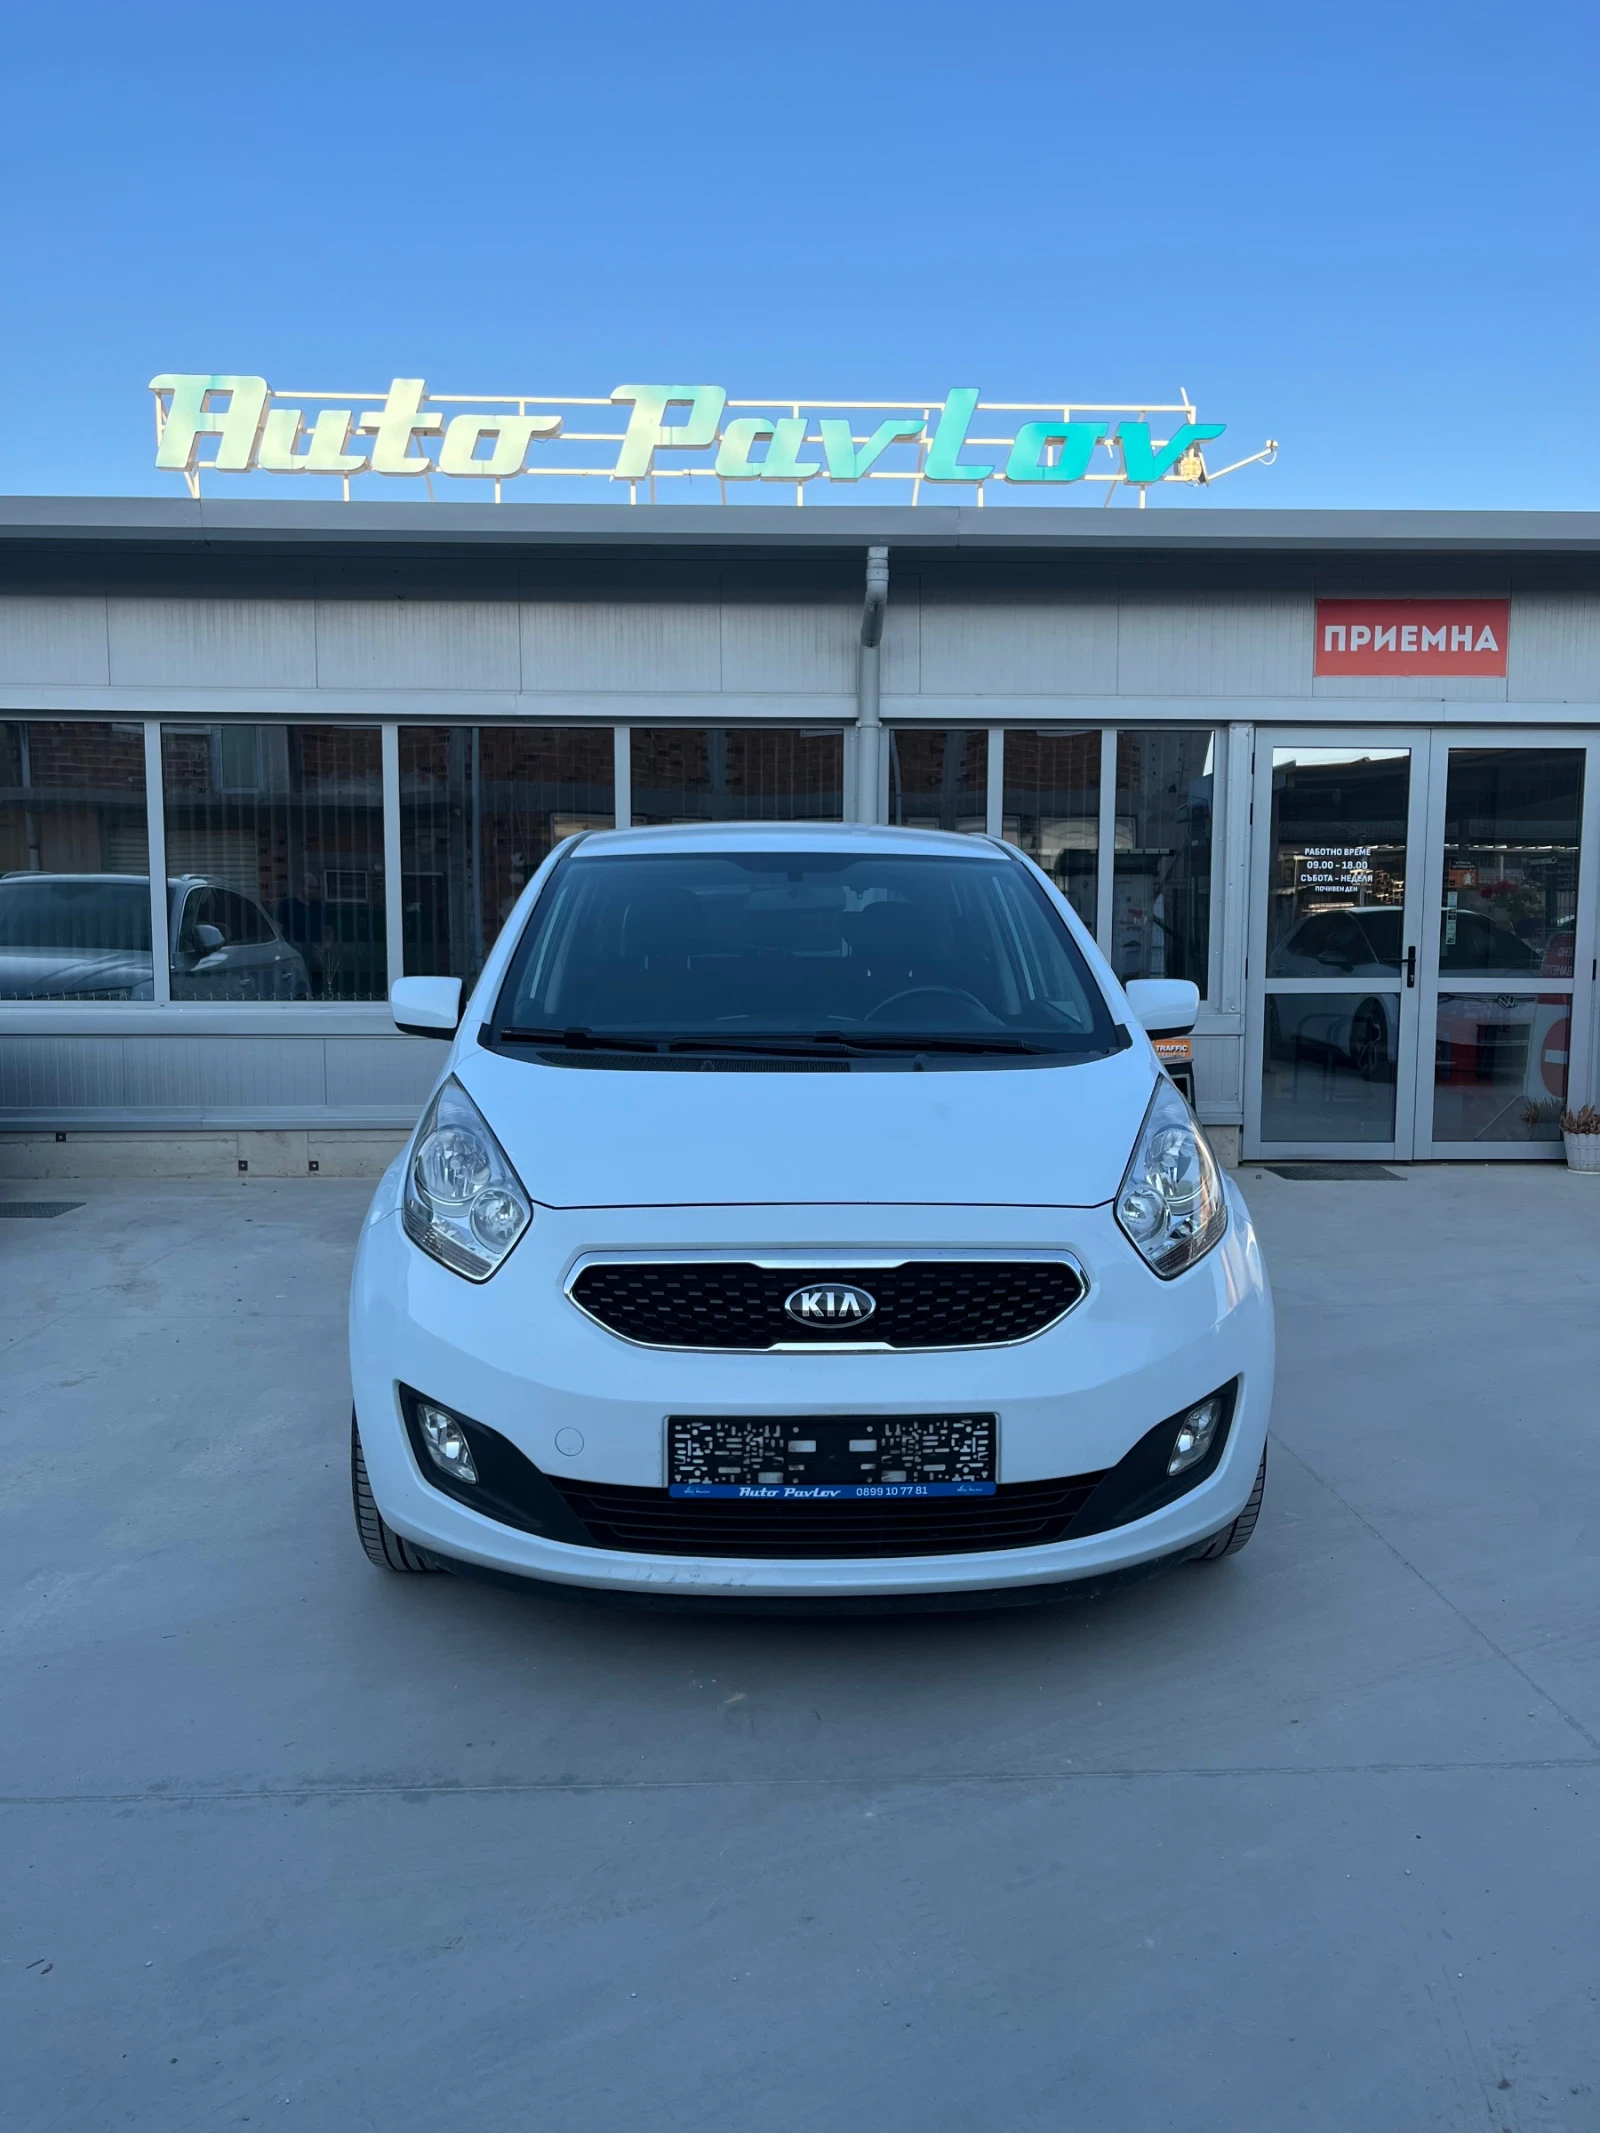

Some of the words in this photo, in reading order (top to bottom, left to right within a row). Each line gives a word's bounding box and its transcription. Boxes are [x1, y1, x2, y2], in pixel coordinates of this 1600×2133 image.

[148, 373, 564, 480] Auto
[1323, 624, 1500, 652] ПРИЕМНА
[1304, 847, 1342, 856] РАБОТНО
[1343, 848, 1372, 856] ВРЕМЕ
[1306, 860, 1334, 870] 09.00
[1341, 860, 1368, 870] 18.00
[1300, 874, 1334, 882] СЪБОТА
[1340, 874, 1373, 883] НЕДЕЛЯ
[1345, 885, 1358, 893] ДЕН
[1155, 1044, 1188, 1053] TRAFFIC
[800, 1292, 862, 1317] KIA
[738, 1486, 779, 1497] Auto
[856, 1487, 884, 1497] 0899
[885, 1487, 899, 1496] 10
[900, 1486, 914, 1496] 77
[915, 1486, 928, 1495] 81
